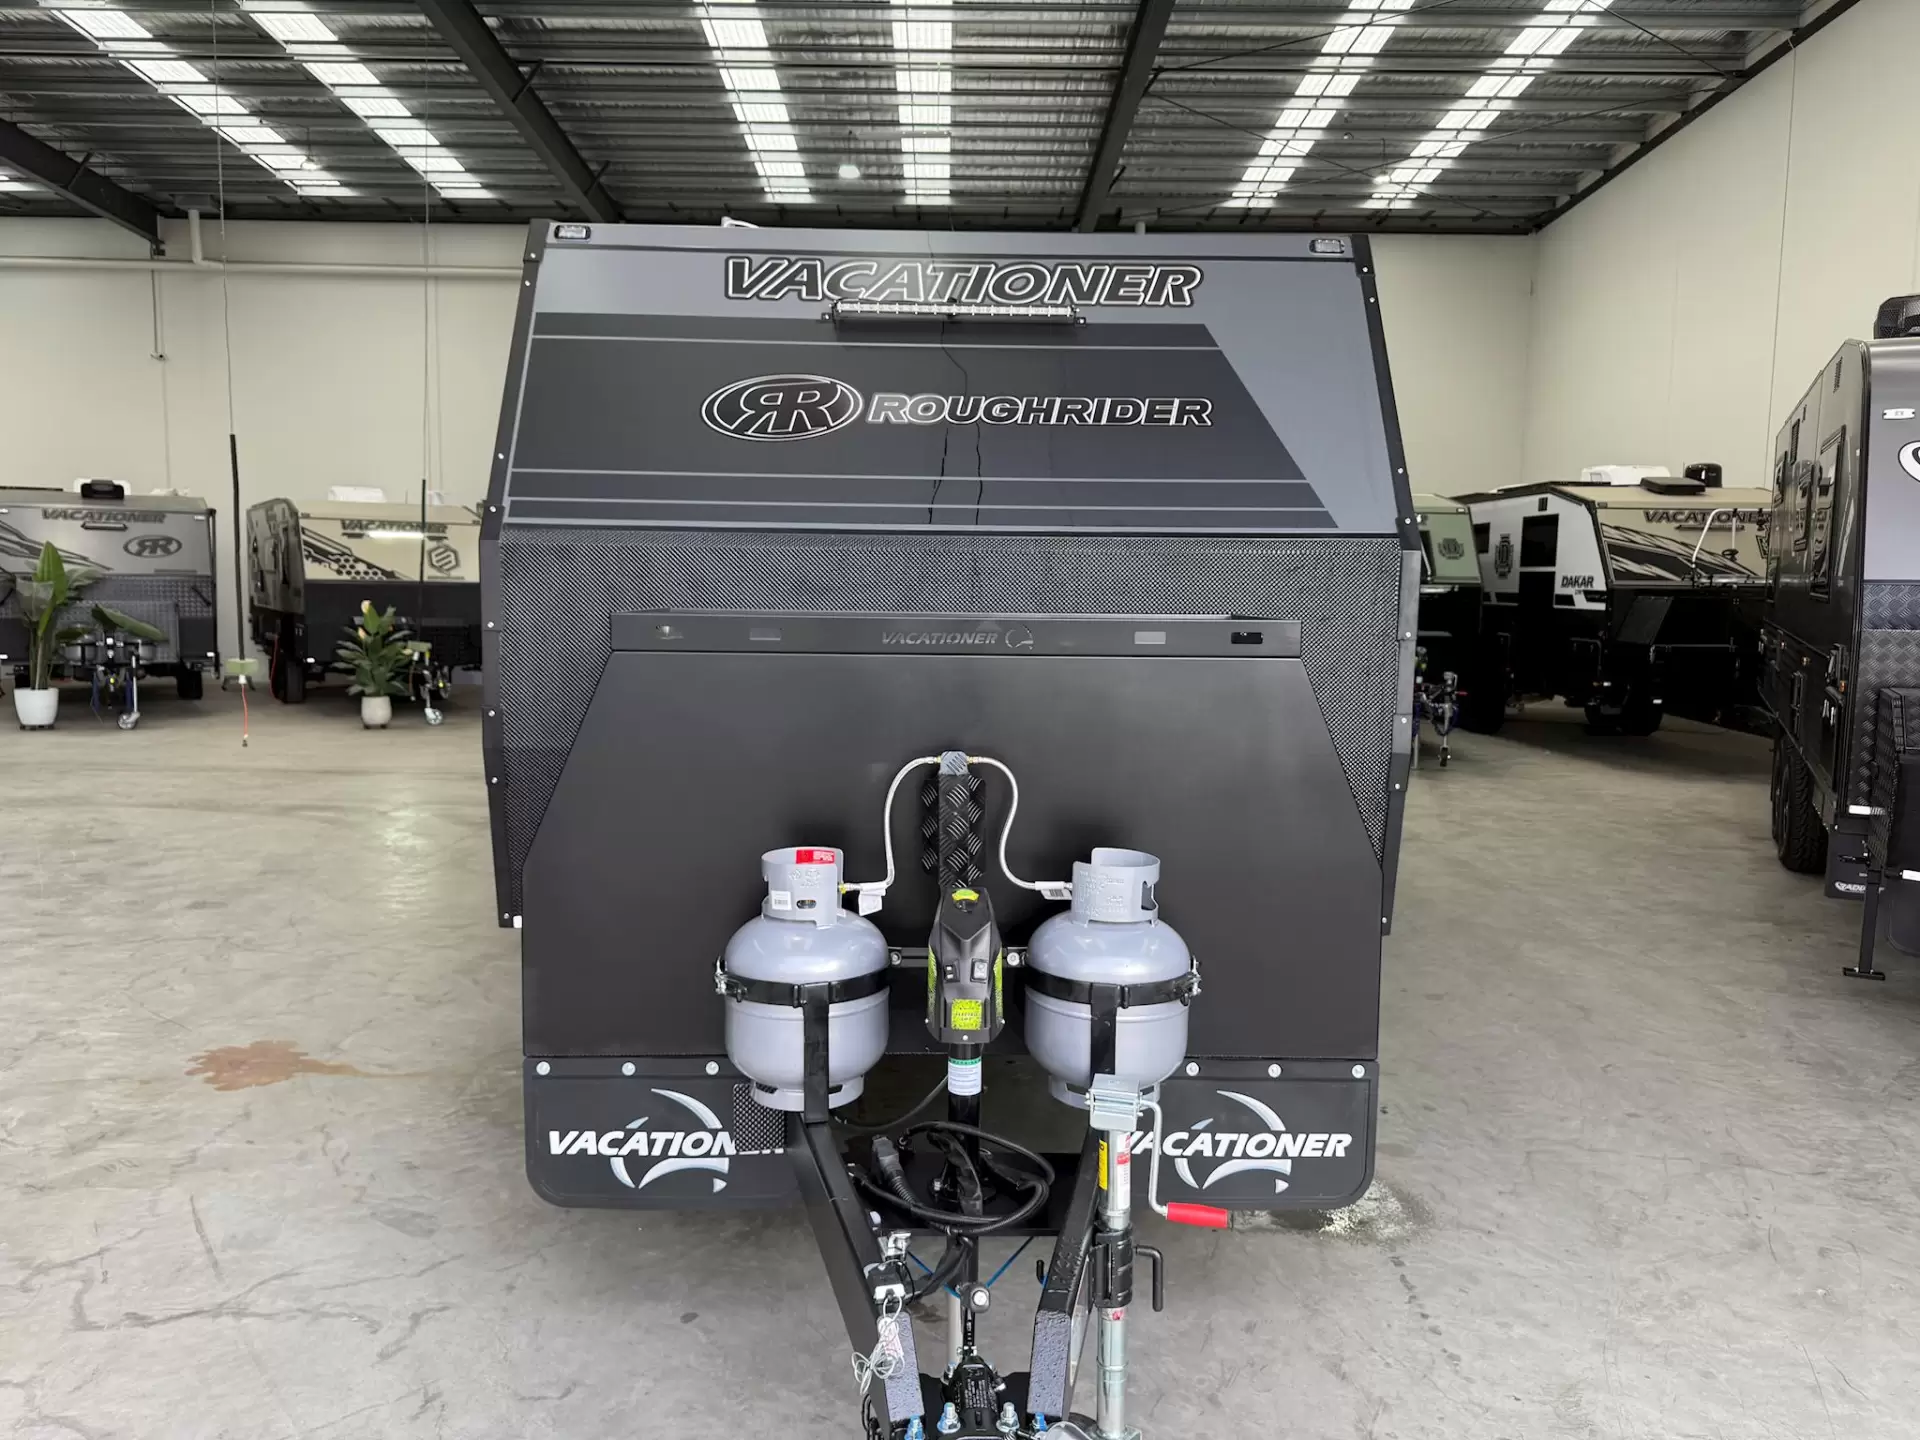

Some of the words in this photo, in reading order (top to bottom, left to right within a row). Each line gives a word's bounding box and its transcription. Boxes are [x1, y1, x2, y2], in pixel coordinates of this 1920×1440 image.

[725, 257, 1203, 306] VACATIONER
[867, 393, 1214, 427] ROUGHRIDER
[42, 508, 166, 524] VACATIONER
[1560, 575, 1594, 589] DAKAR
[881, 631, 999, 645] VACATIONER
[549, 1130, 785, 1157] VACATION
